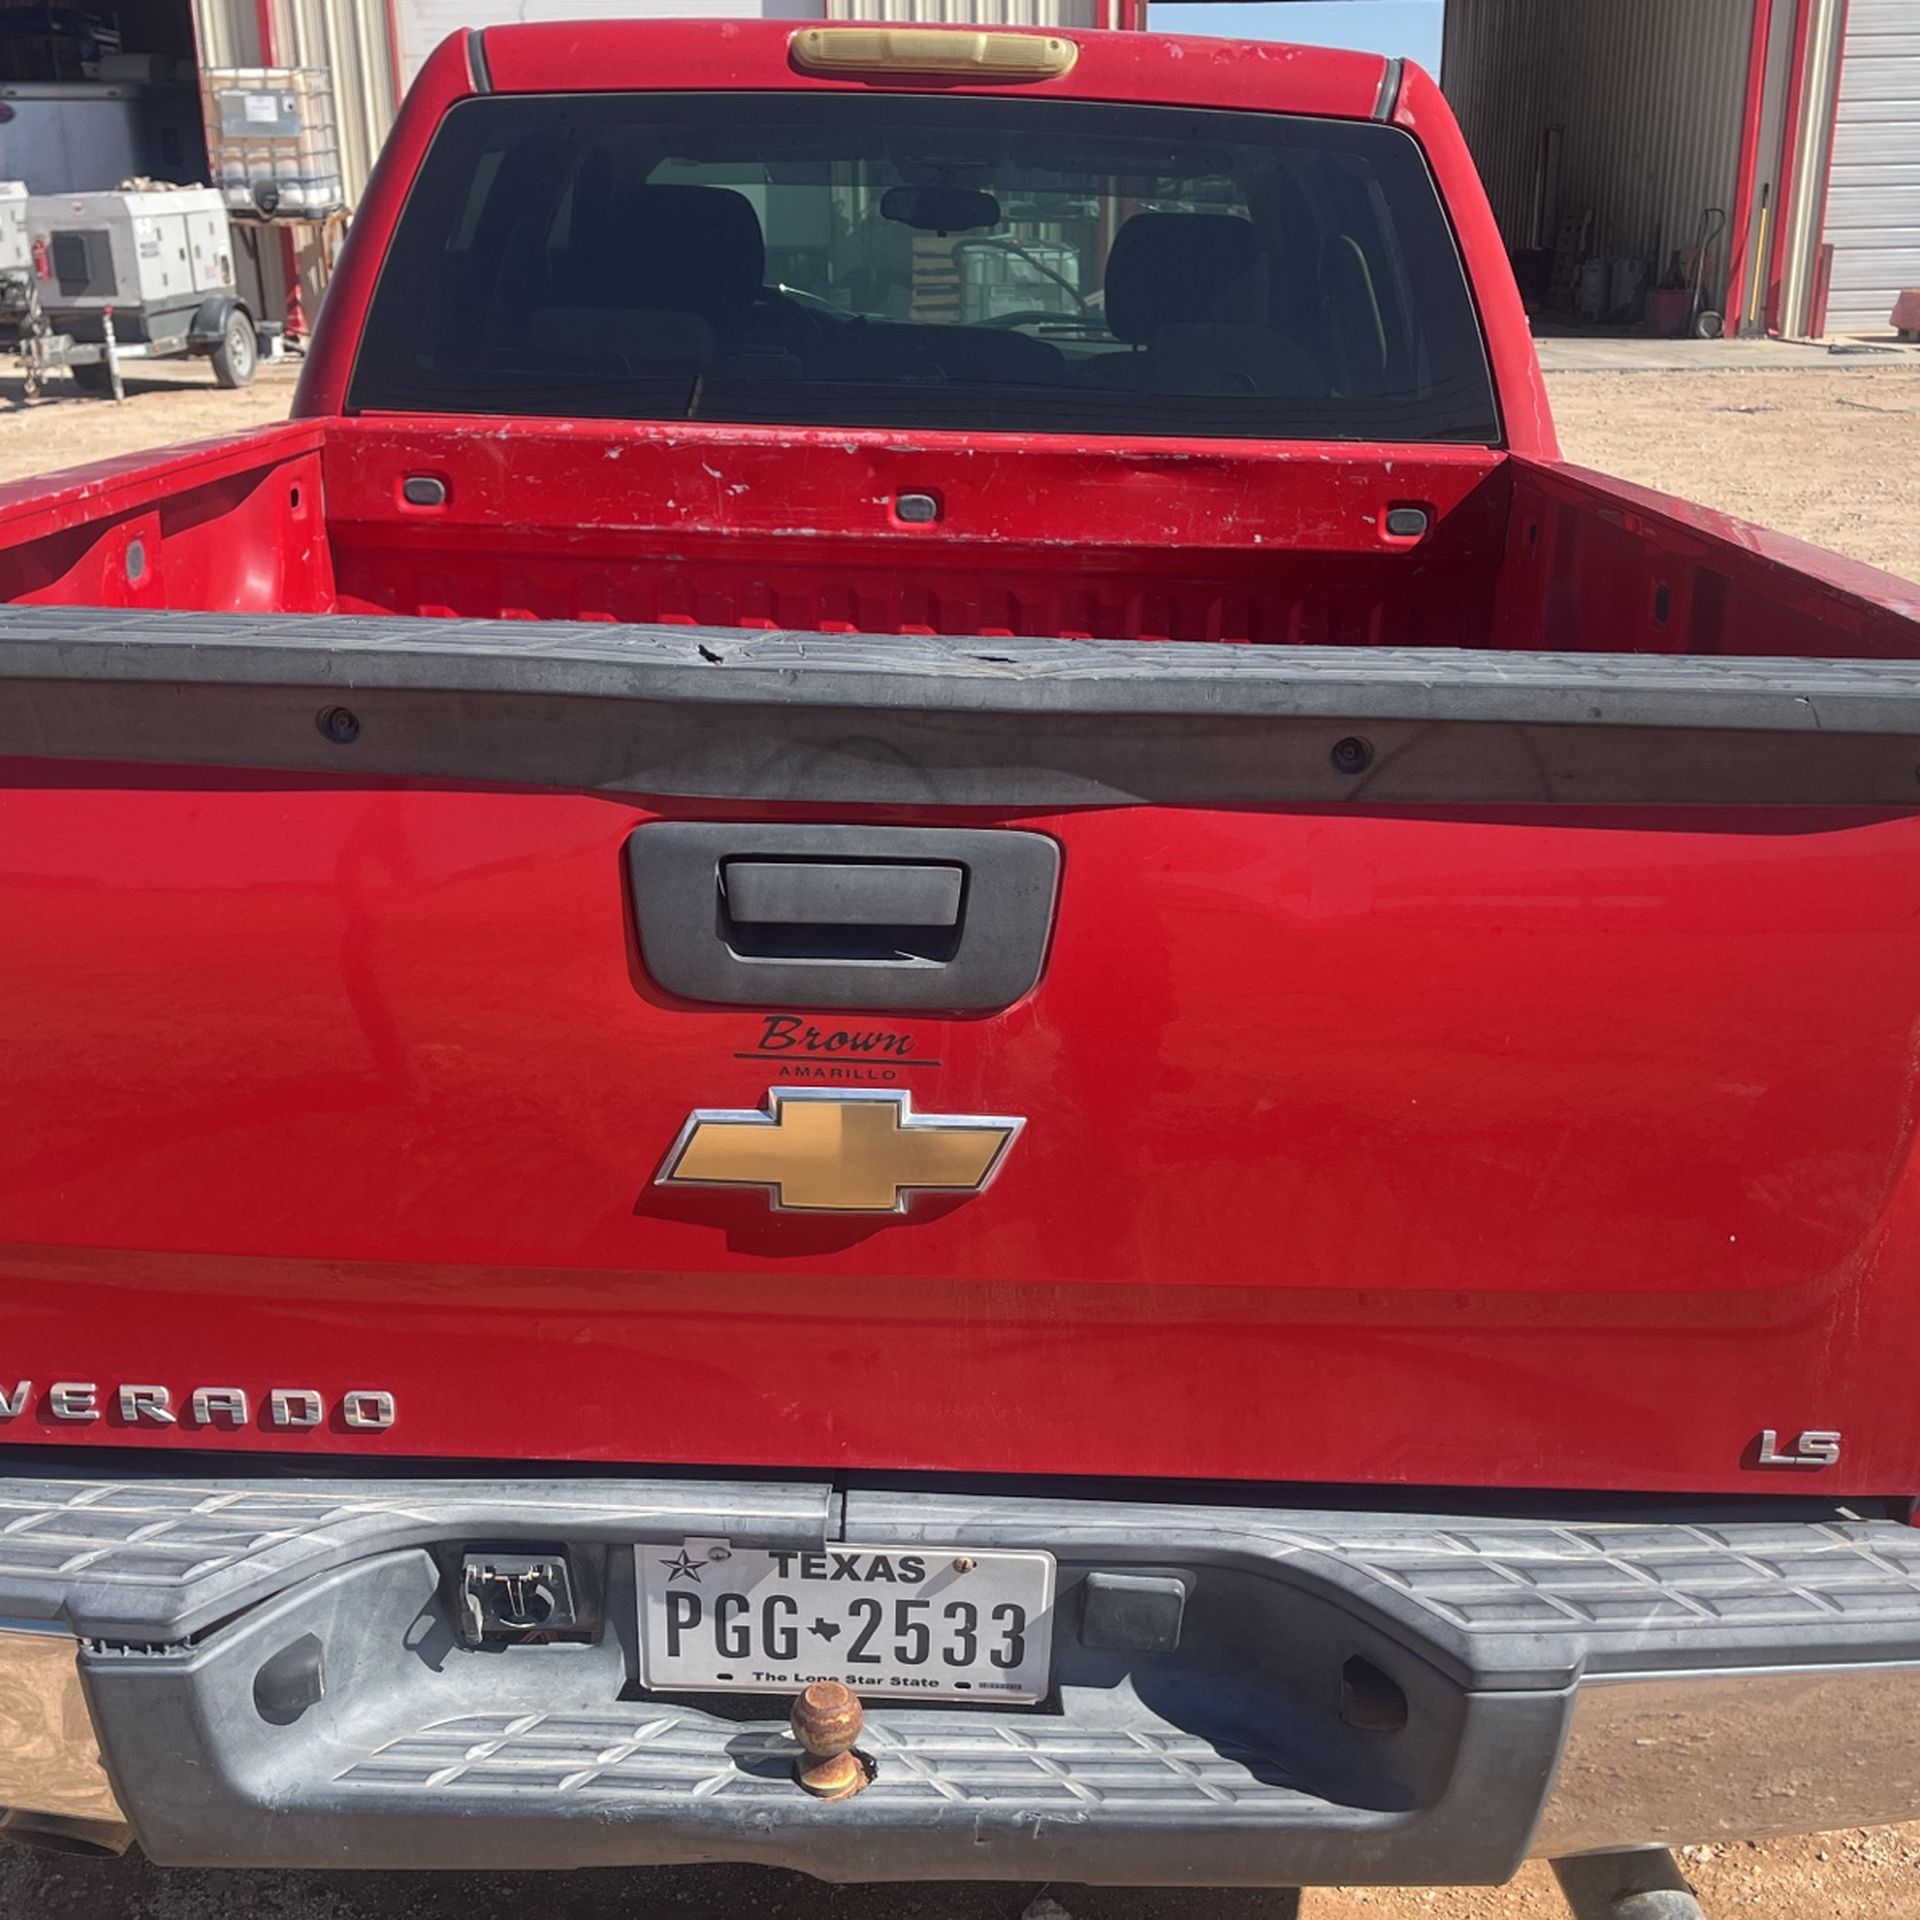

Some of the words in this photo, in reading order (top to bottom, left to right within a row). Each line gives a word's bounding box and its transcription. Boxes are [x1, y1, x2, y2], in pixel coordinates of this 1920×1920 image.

[757, 1014, 915, 1055] Brown
[779, 1065, 897, 1080] AMARILLO
[1759, 1429, 1841, 1464] LS
[768, 1551, 926, 1584] TEXAS
[665, 1591, 799, 1660] PGG
[846, 1598, 1026, 1669] 2533
[753, 1672, 788, 1682] The
[846, 1675, 884, 1686] Star
[890, 1676, 940, 1688] State
